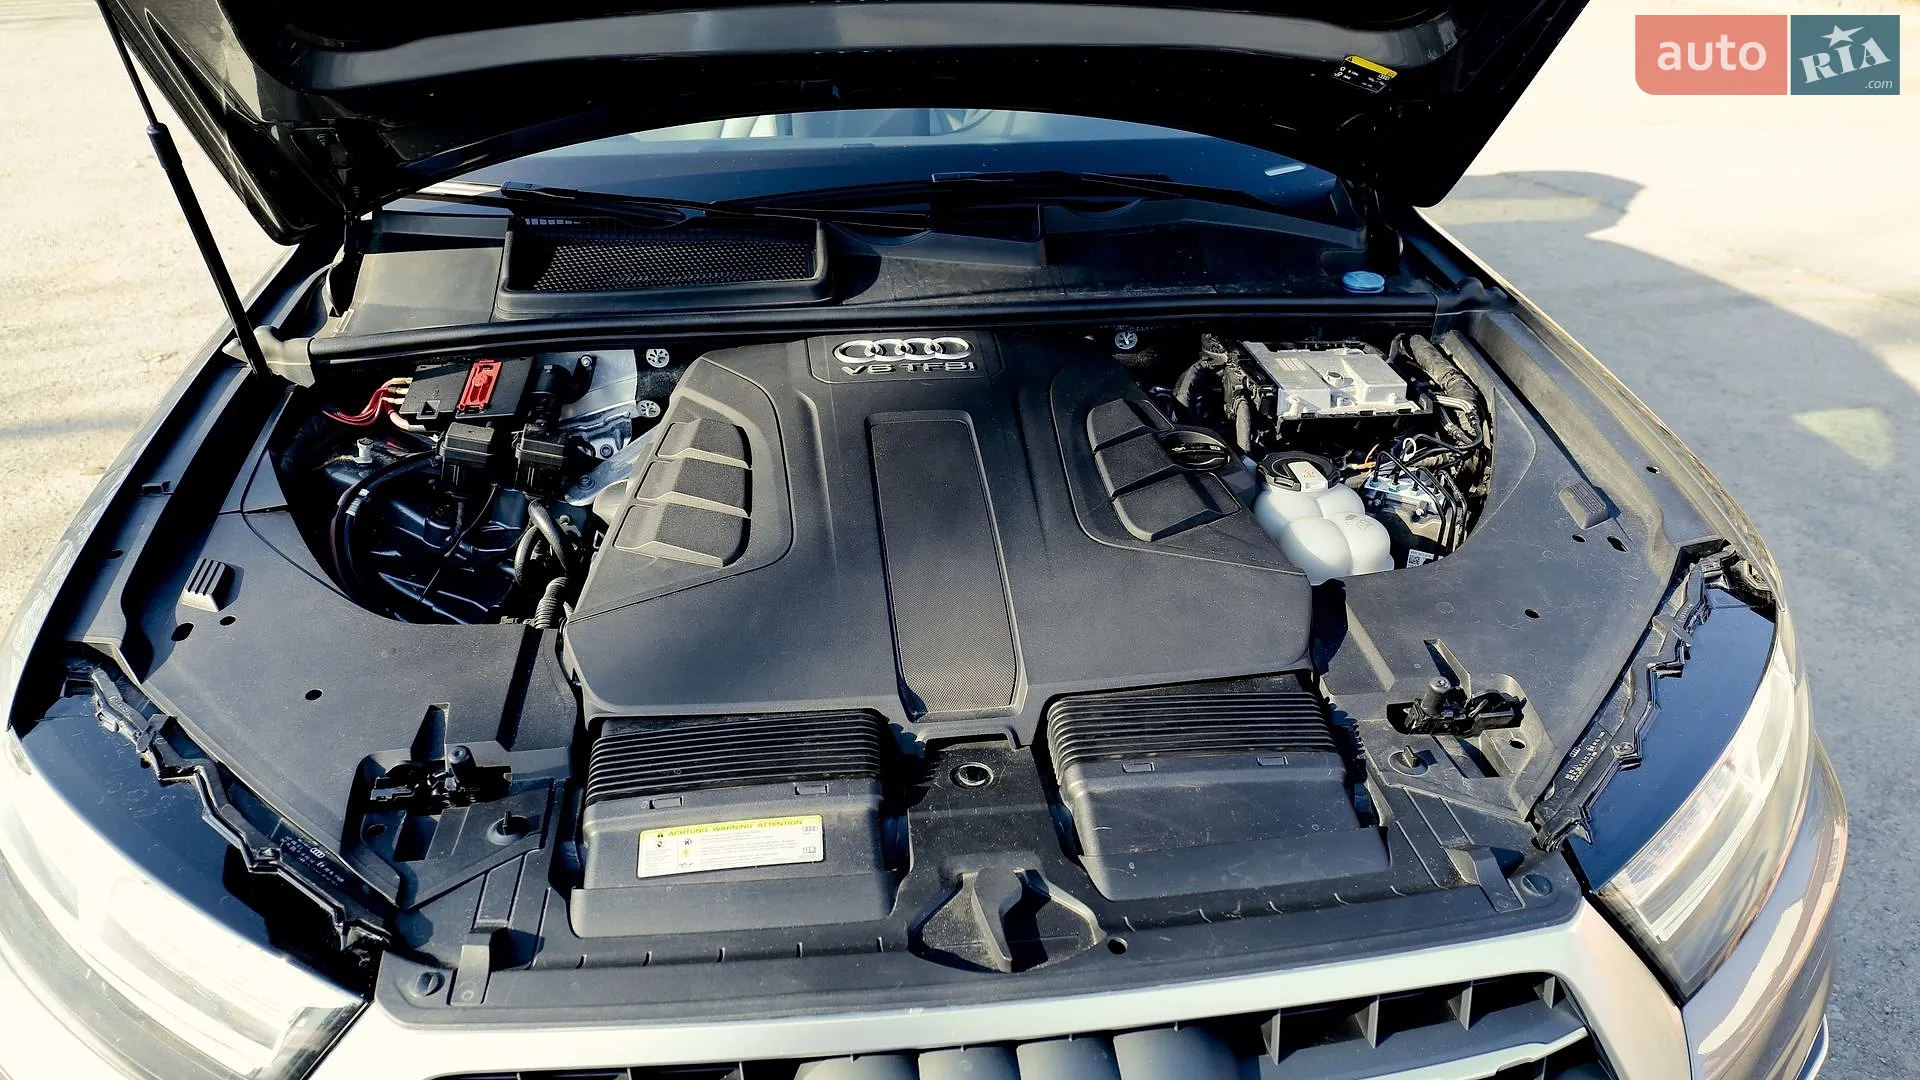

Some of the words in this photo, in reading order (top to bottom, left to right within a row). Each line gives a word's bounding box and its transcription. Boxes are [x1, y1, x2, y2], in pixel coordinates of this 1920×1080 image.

[841, 363, 893, 375] V6
[900, 361, 974, 373] TFSI
[668, 827, 708, 837] ACHTUNG
[712, 822, 753, 832] WARNING
[756, 818, 803, 828] ATTENTION
